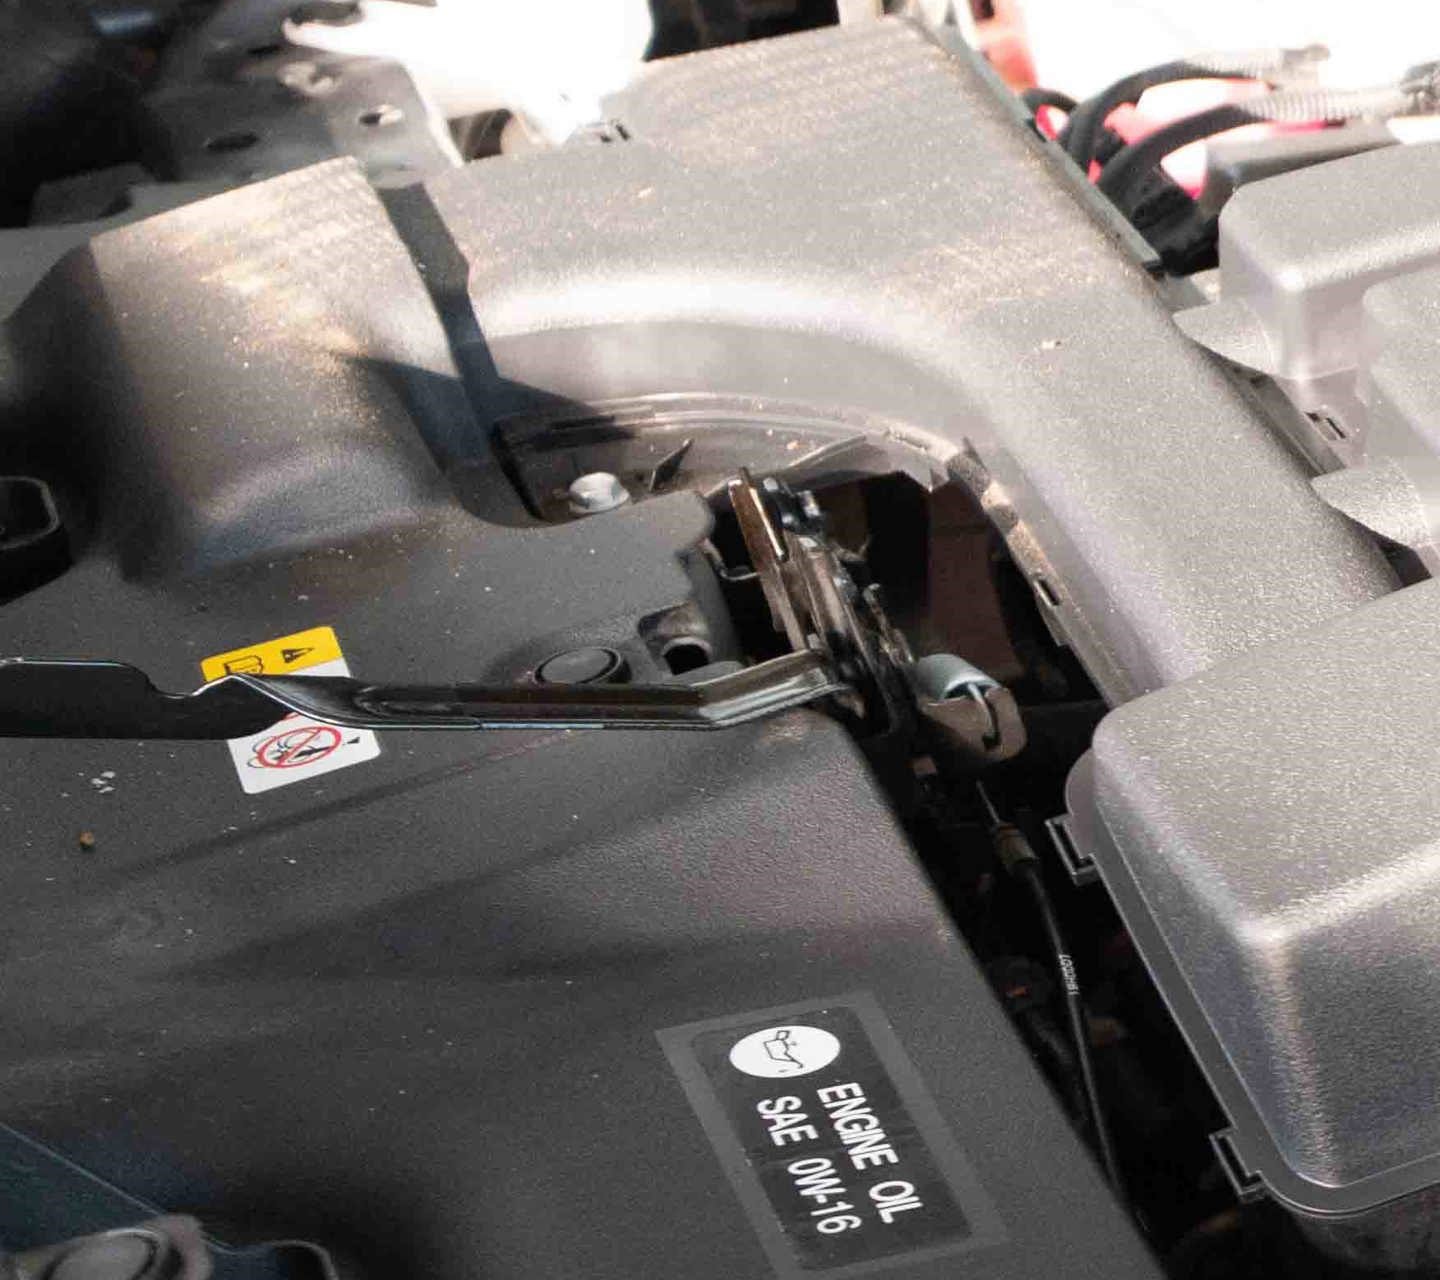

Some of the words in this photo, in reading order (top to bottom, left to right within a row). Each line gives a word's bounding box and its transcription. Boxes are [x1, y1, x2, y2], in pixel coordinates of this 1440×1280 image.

[755, 1095, 819, 1147] SAE
[787, 1157, 862, 1235] 0W-16
[815, 1081, 899, 1170] ENGINE
[868, 1179, 923, 1224] OIL
